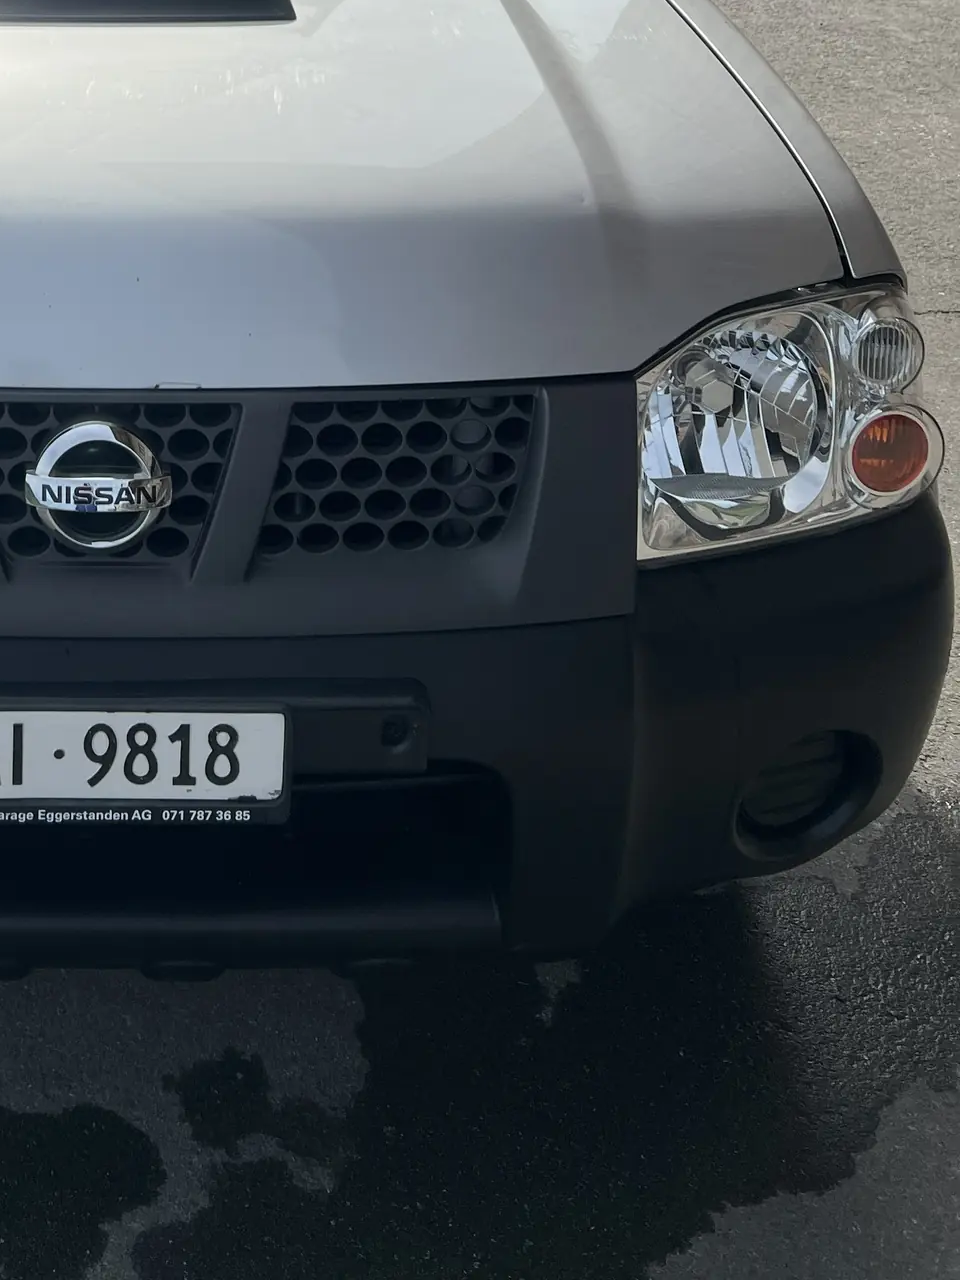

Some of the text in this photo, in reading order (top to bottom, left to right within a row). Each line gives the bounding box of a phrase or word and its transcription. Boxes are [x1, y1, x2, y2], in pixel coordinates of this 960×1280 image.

[41, 483, 157, 505] NISSAN
[83, 723, 240, 788] 9818
[37, 809, 129, 823] Eggerstanden
[131, 809, 152, 822] AG
[162, 809, 185, 822] 071
[189, 809, 213, 822] 787
[215, 809, 232, 822] 36
[234, 809, 251, 822] 85
